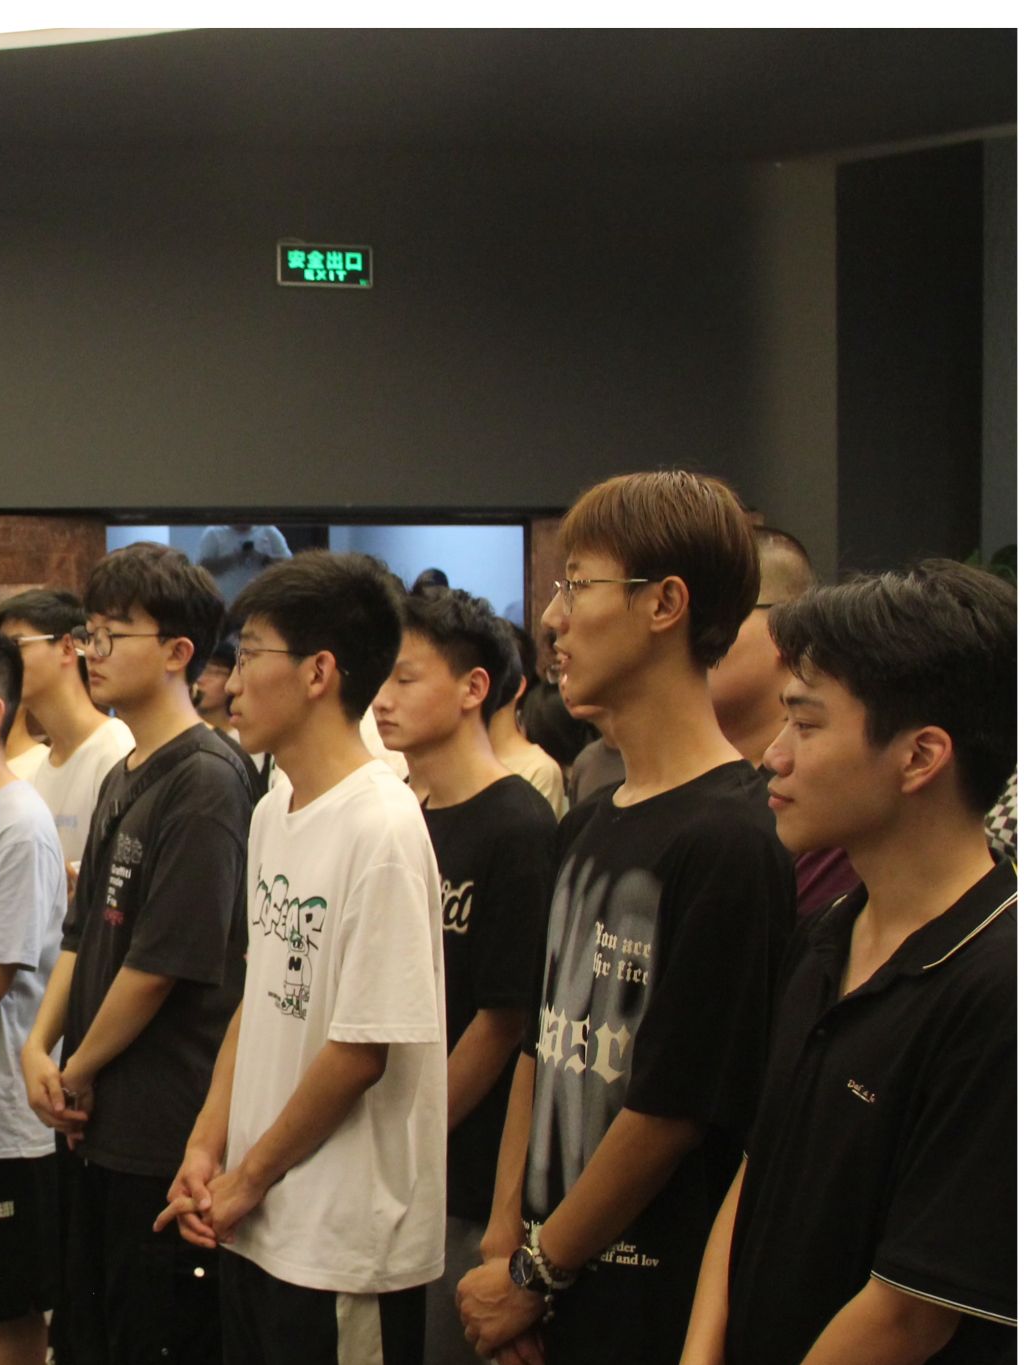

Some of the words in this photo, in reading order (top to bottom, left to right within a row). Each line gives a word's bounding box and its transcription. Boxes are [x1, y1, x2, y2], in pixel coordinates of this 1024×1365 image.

[287, 249, 363, 271] 安全出口
[304, 268, 347, 281] EXIT
[616, 1253, 640, 1266] and
